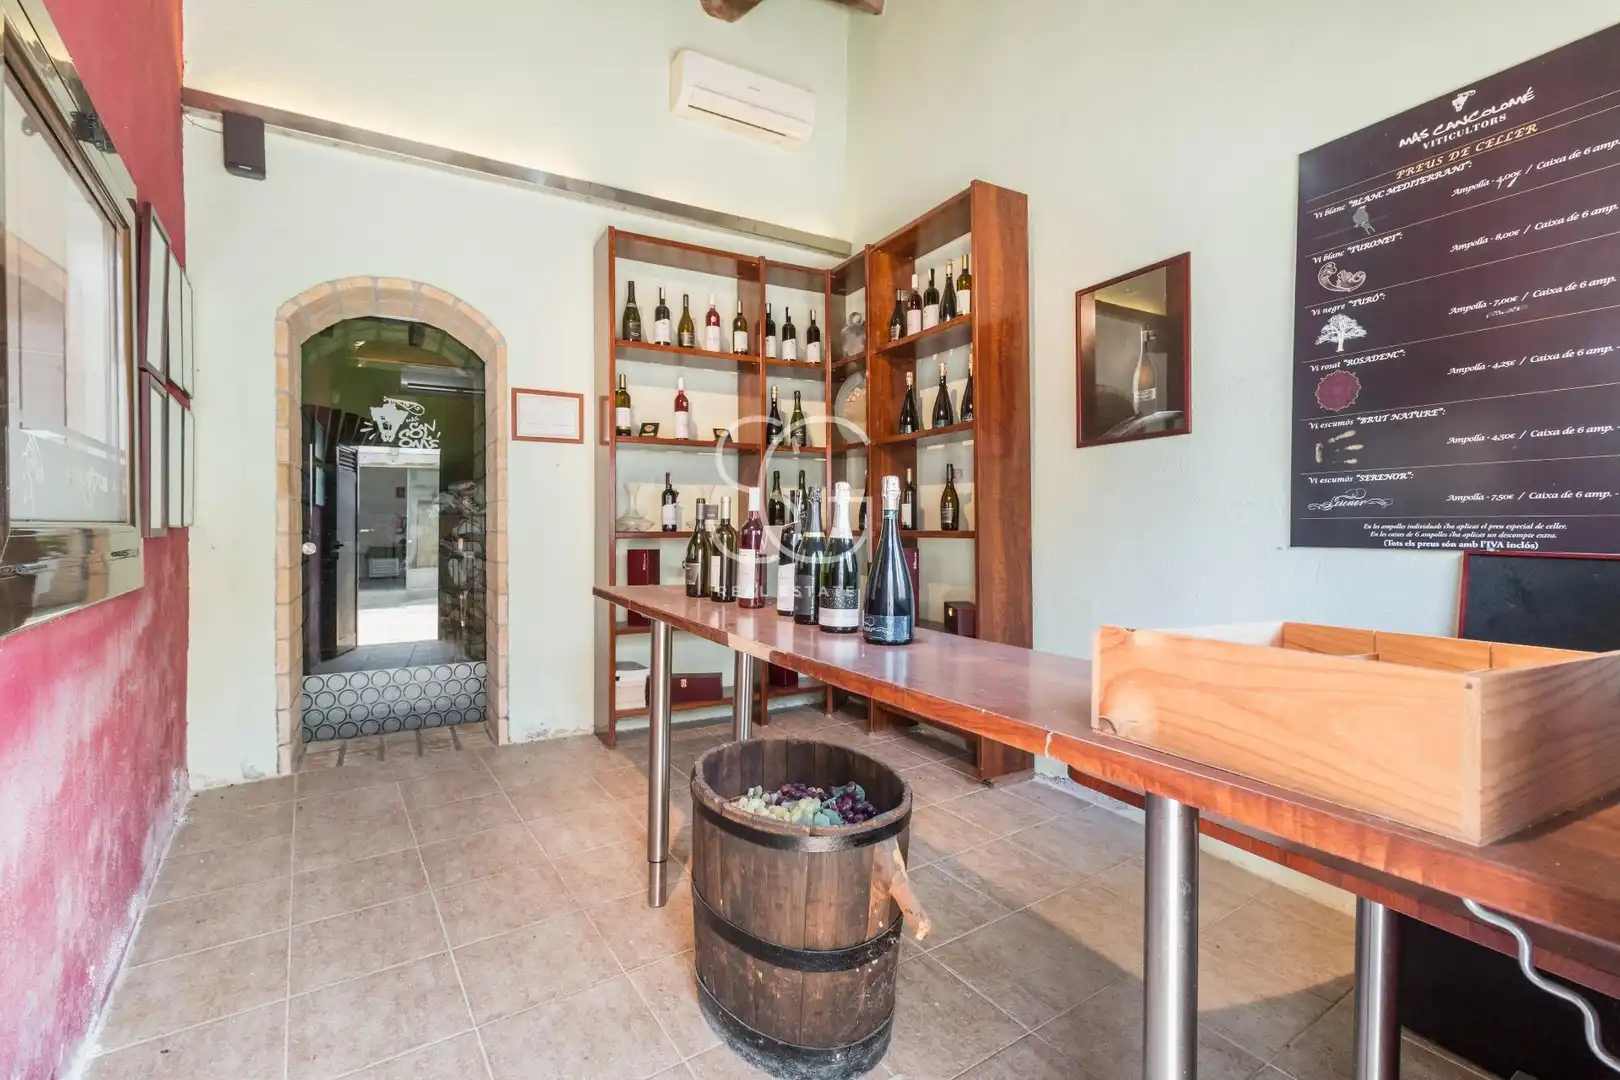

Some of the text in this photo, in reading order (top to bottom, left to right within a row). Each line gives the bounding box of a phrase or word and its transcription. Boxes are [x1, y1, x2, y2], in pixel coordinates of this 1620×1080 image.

[1399, 128, 1429, 148] MAS
[1423, 114, 1507, 149] VITICULTORS
[1396, 124, 1538, 180] PREUS DE CELLER
[1451, 178, 1490, 196] Ampolla
[1536, 156, 1566, 170] Caixa
[1568, 149, 1582, 160] de
[1584, 146, 1591, 154] 6
[1313, 210, 1323, 220] Vi
[1324, 204, 1346, 217] blanc
[1450, 235, 1488, 252] Ampolla
[1534, 217, 1565, 230] Caixa
[1566, 211, 1580, 222] de
[1582, 210, 1590, 218] 6
[1590, 204, 1619, 216] amp.
[1312, 256, 1322, 264] Vi
[1323, 250, 1345, 262] blanc
[1448, 300, 1487, 315] Ampolla
[1532, 286, 1562, 298] Caixa
[1564, 281, 1578, 292] de
[1580, 280, 1587, 288] 6
[1588, 276, 1617, 289] amp.
[1310, 308, 1321, 317] Vi
[1322, 304, 1346, 314] negre
[1320, 361, 1342, 370] rosat
[1447, 362, 1486, 376] Ampolla
[1530, 351, 1560, 364] Caixa
[1562, 348, 1576, 359] de
[1576, 348, 1584, 356] 6
[1586, 344, 1614, 356] amp.
[1308, 422, 1319, 430] Vi
[1320, 419, 1354, 429] escumós
[1446, 433, 1486, 446] Ampolla
[1530, 427, 1560, 438] Caixa
[1562, 426, 1575, 436] de
[1576, 426, 1585, 434] 6
[1586, 424, 1614, 435] amp.
[1308, 476, 1318, 484] Vi
[1320, 476, 1353, 484] escumós
[1446, 492, 1485, 504] Ampolla
[1528, 491, 1559, 500] Caixa
[1560, 490, 1574, 500] de
[1575, 490, 1584, 499] 6
[1584, 490, 1613, 501] amp.
[1506, 523, 1534, 532] especial
[1498, 532, 1535, 540] descompte
[1383, 539, 1404, 548] (Tots
[1416, 541, 1440, 550] preus
[1458, 540, 1478, 548] amb
[1506, 540, 1540, 550] inclós)
